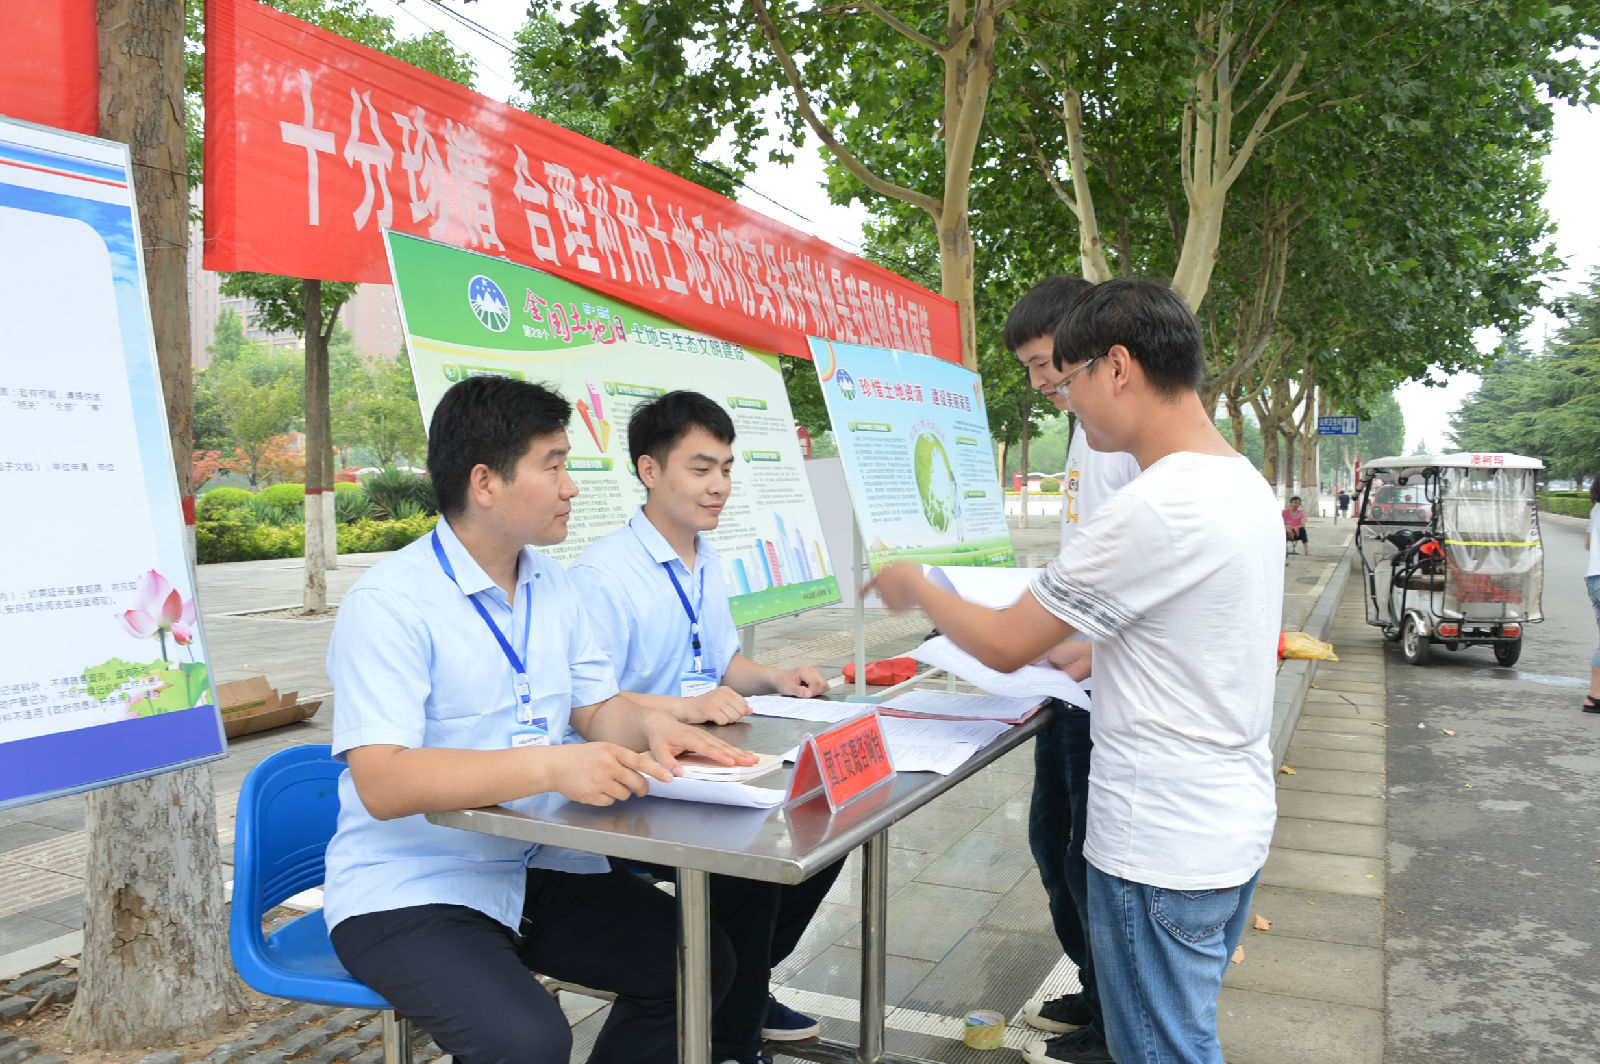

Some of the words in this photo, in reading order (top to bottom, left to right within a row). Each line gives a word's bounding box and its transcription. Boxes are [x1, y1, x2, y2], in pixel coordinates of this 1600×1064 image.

[280, 68, 505, 251] 十分珍惜
[523, 288, 627, 345] 全国土地日
[632, 323, 746, 362] 土地与生态文明建设
[858, 378, 924, 404] 珍惜土地资源
